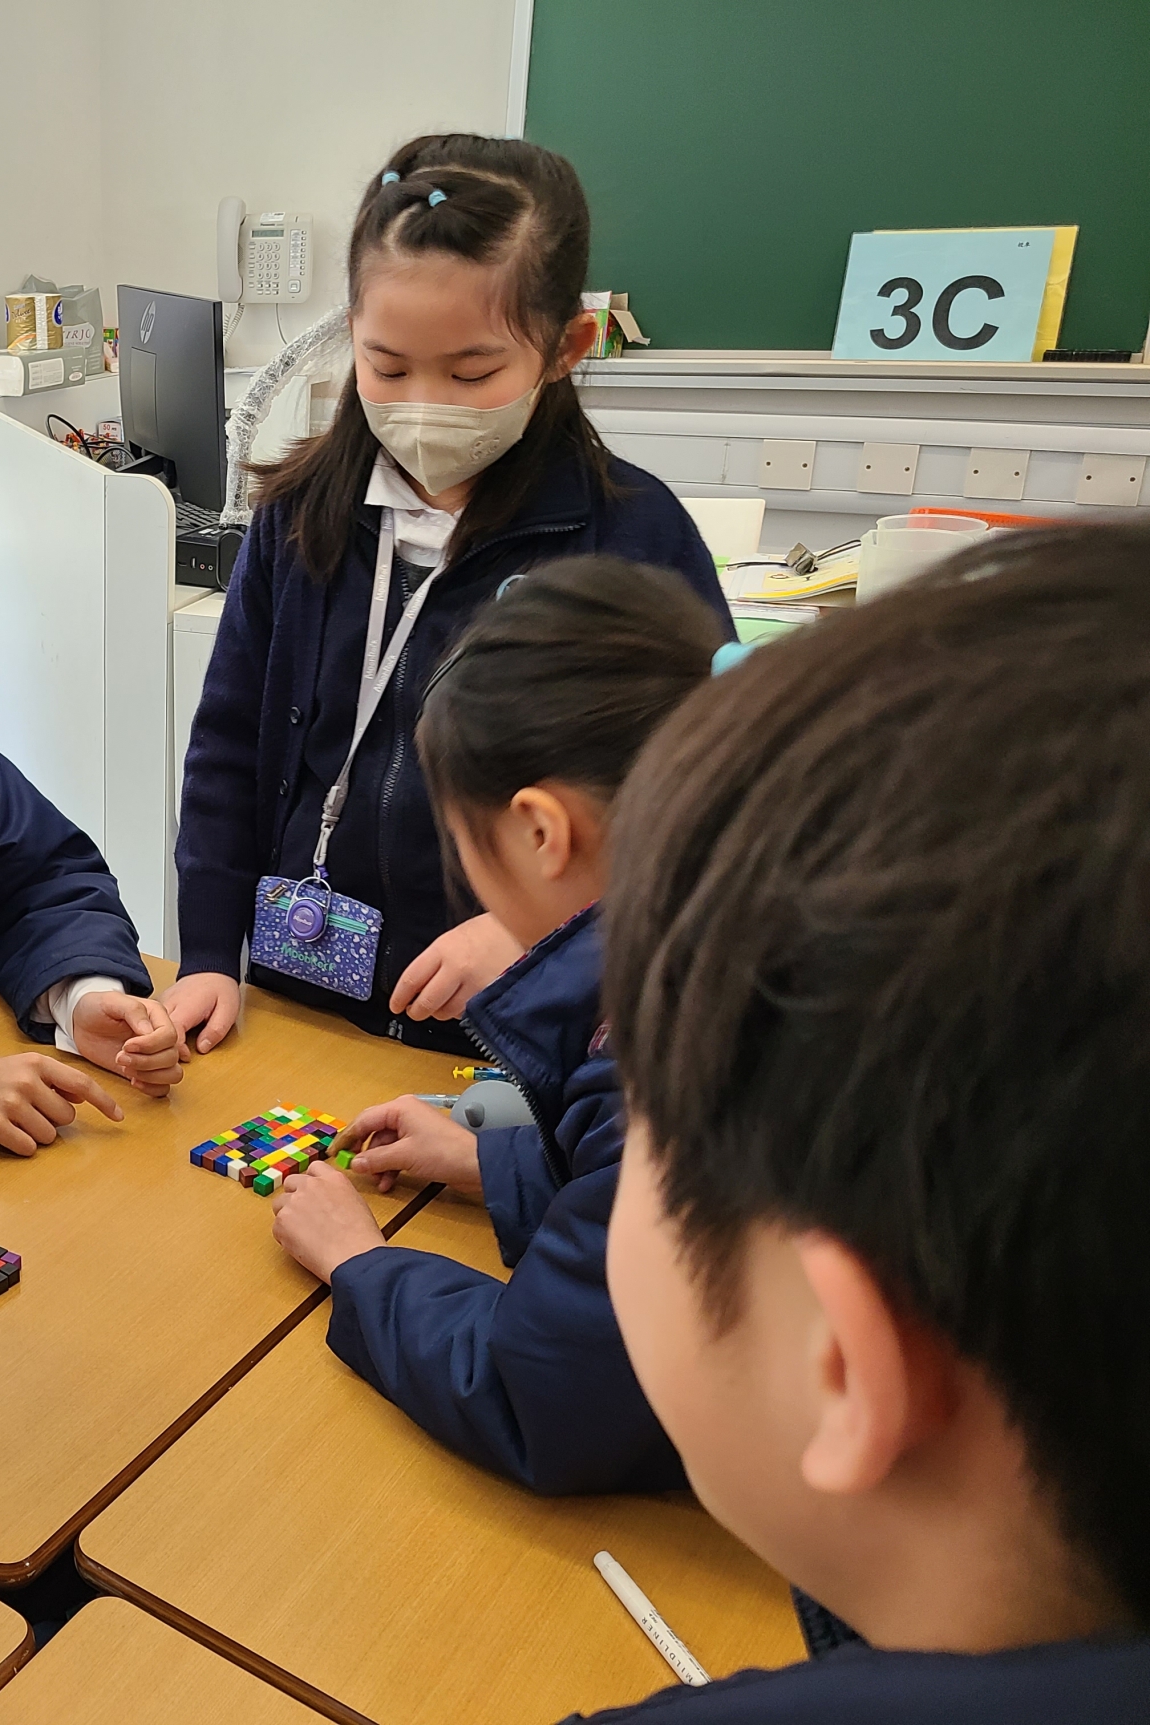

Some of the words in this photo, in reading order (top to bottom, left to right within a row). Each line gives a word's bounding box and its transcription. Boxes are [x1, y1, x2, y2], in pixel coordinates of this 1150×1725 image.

[140, 300, 156, 344] hp
[869, 274, 1006, 351] 3C
[640, 1616, 694, 1684] MILDLINER
